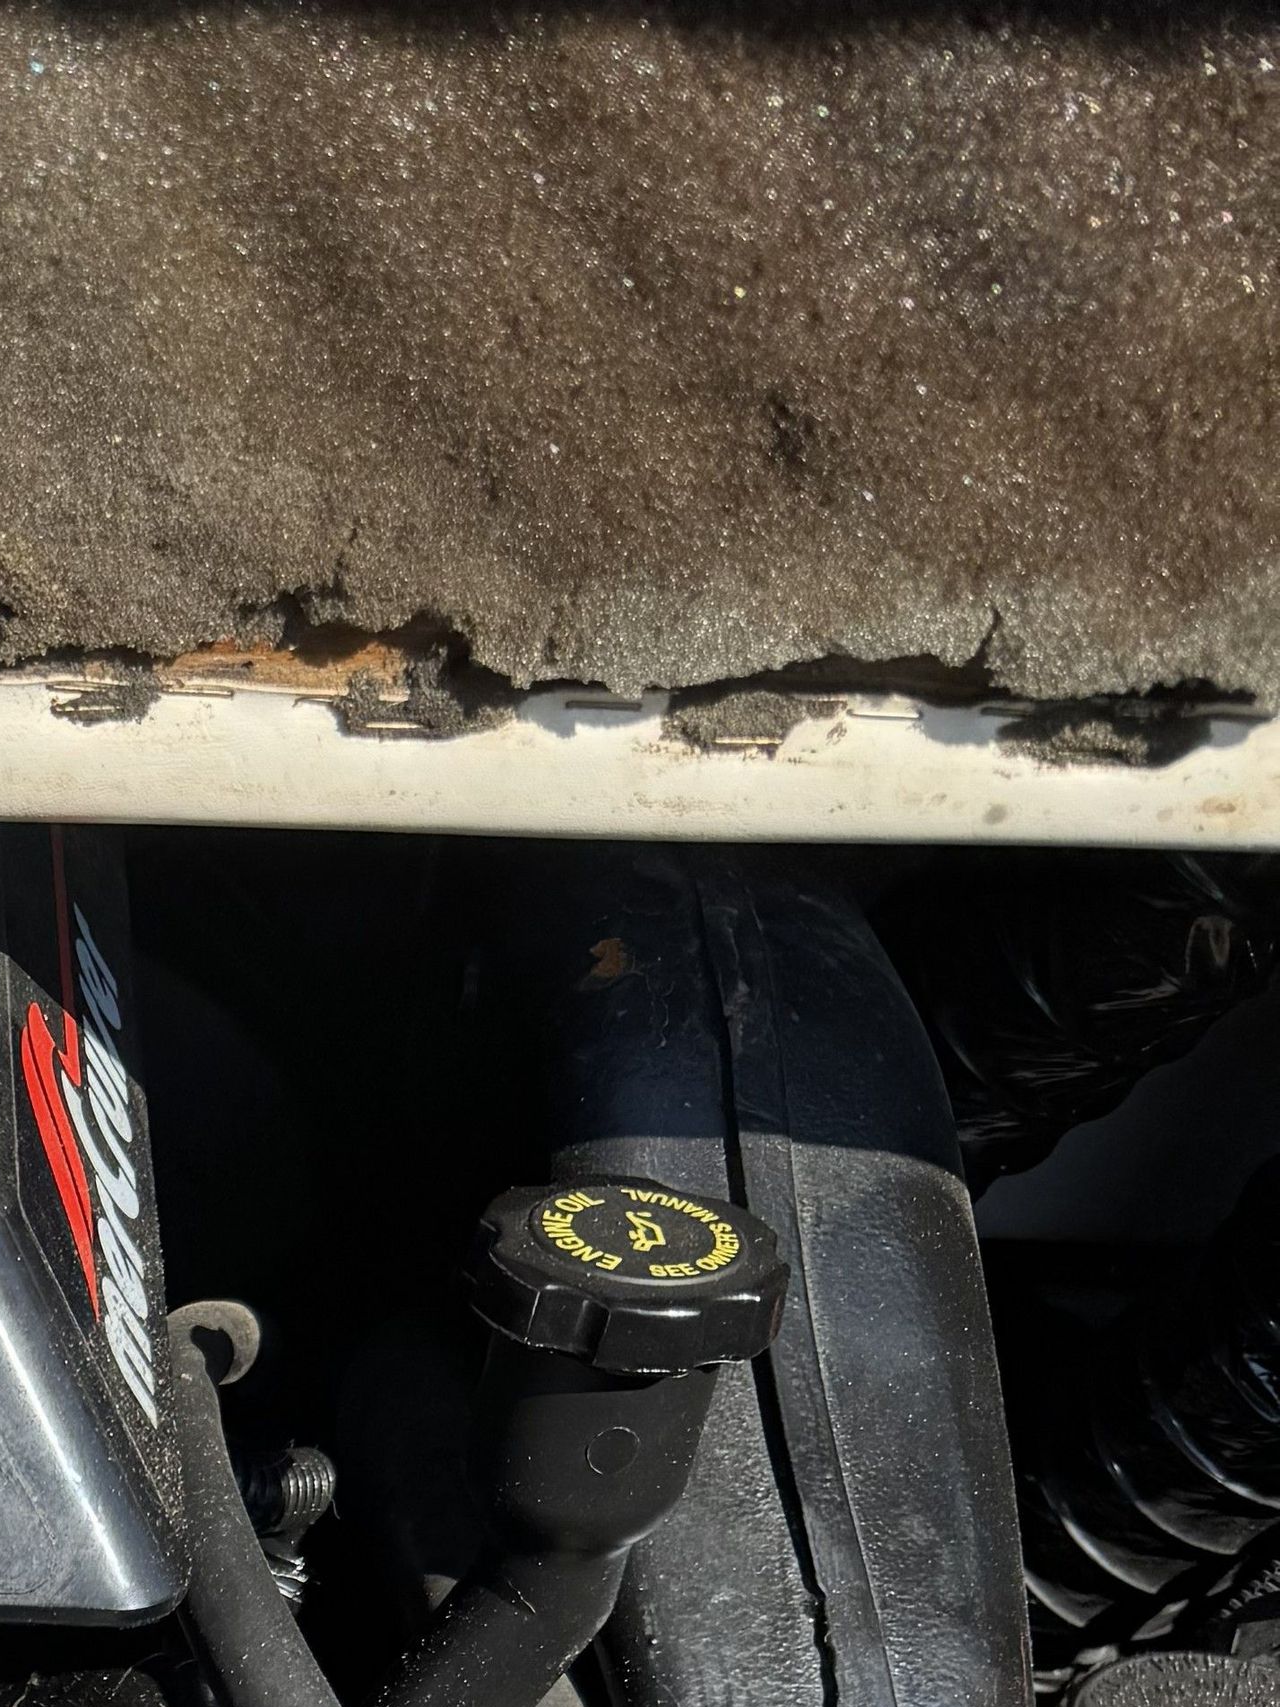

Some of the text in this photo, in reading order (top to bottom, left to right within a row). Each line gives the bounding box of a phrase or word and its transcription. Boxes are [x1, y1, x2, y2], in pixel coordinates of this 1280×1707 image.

[621, 1188, 719, 1223] MANUAL
[542, 1192, 622, 1270] ENGINE OIL
[649, 1263, 700, 1277] SEE
